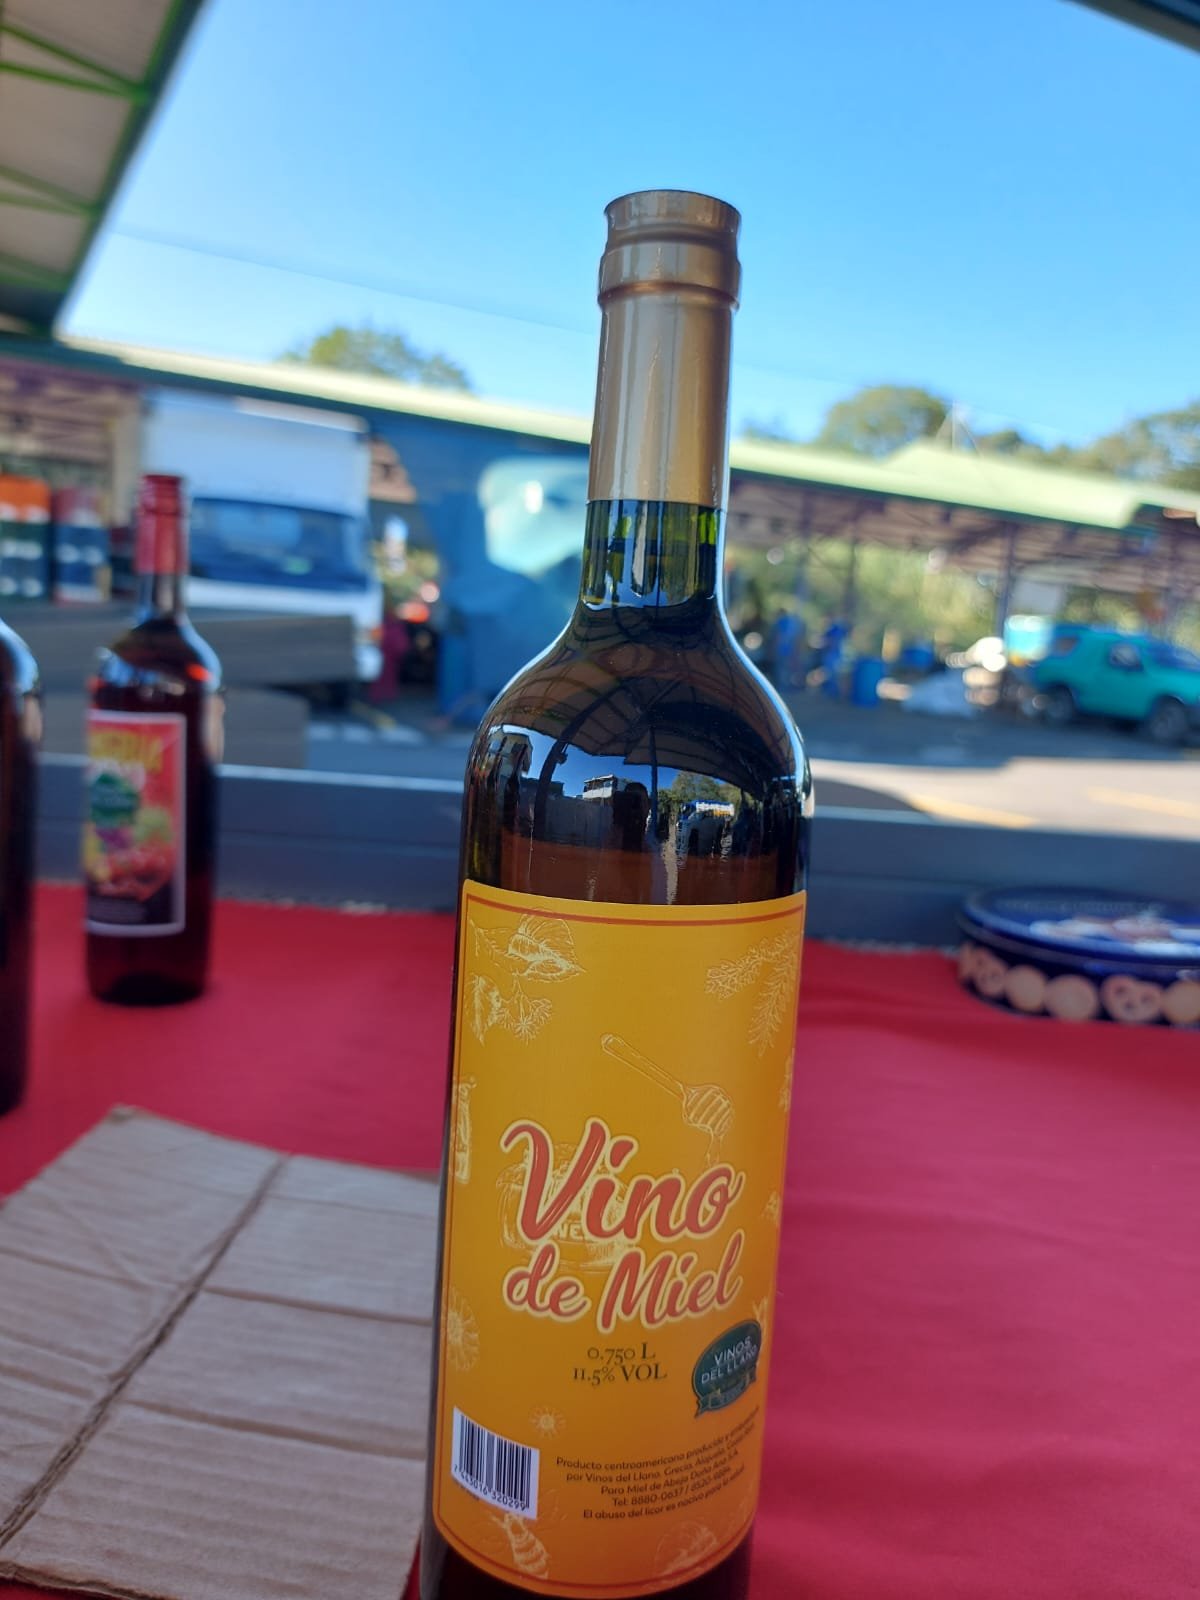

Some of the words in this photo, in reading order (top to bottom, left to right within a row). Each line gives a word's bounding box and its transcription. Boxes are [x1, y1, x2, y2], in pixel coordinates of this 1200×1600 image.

[499, 1117, 745, 1242] Vino
[502, 1243, 591, 1319] de
[597, 1228, 743, 1335] Miel
[587, 1347, 636, 1366] 0.750
[641, 1342, 656, 1360] L
[714, 1335, 753, 1366] VINOS
[573, 1366, 616, 1387] 11.5%
[621, 1363, 668, 1382] VOL
[701, 1367, 724, 1385] DEL
[556, 1457, 602, 1470] Producto
[604, 1452, 685, 1470] centroamericano
[566, 1473, 582, 1482] por
[585, 1473, 613, 1483] Vinos
[615, 1472, 631, 1482] del
[600, 1486, 625, 1495] Para
[627, 1482, 648, 1494] Miel
[649, 1481, 661, 1491] de
[583, 1509, 593, 1519] El
[595, 1509, 626, 1519] abuso
[628, 1507, 643, 1518] del
[645, 1504, 664, 1516] licor
[665, 1502, 677, 1512] es
